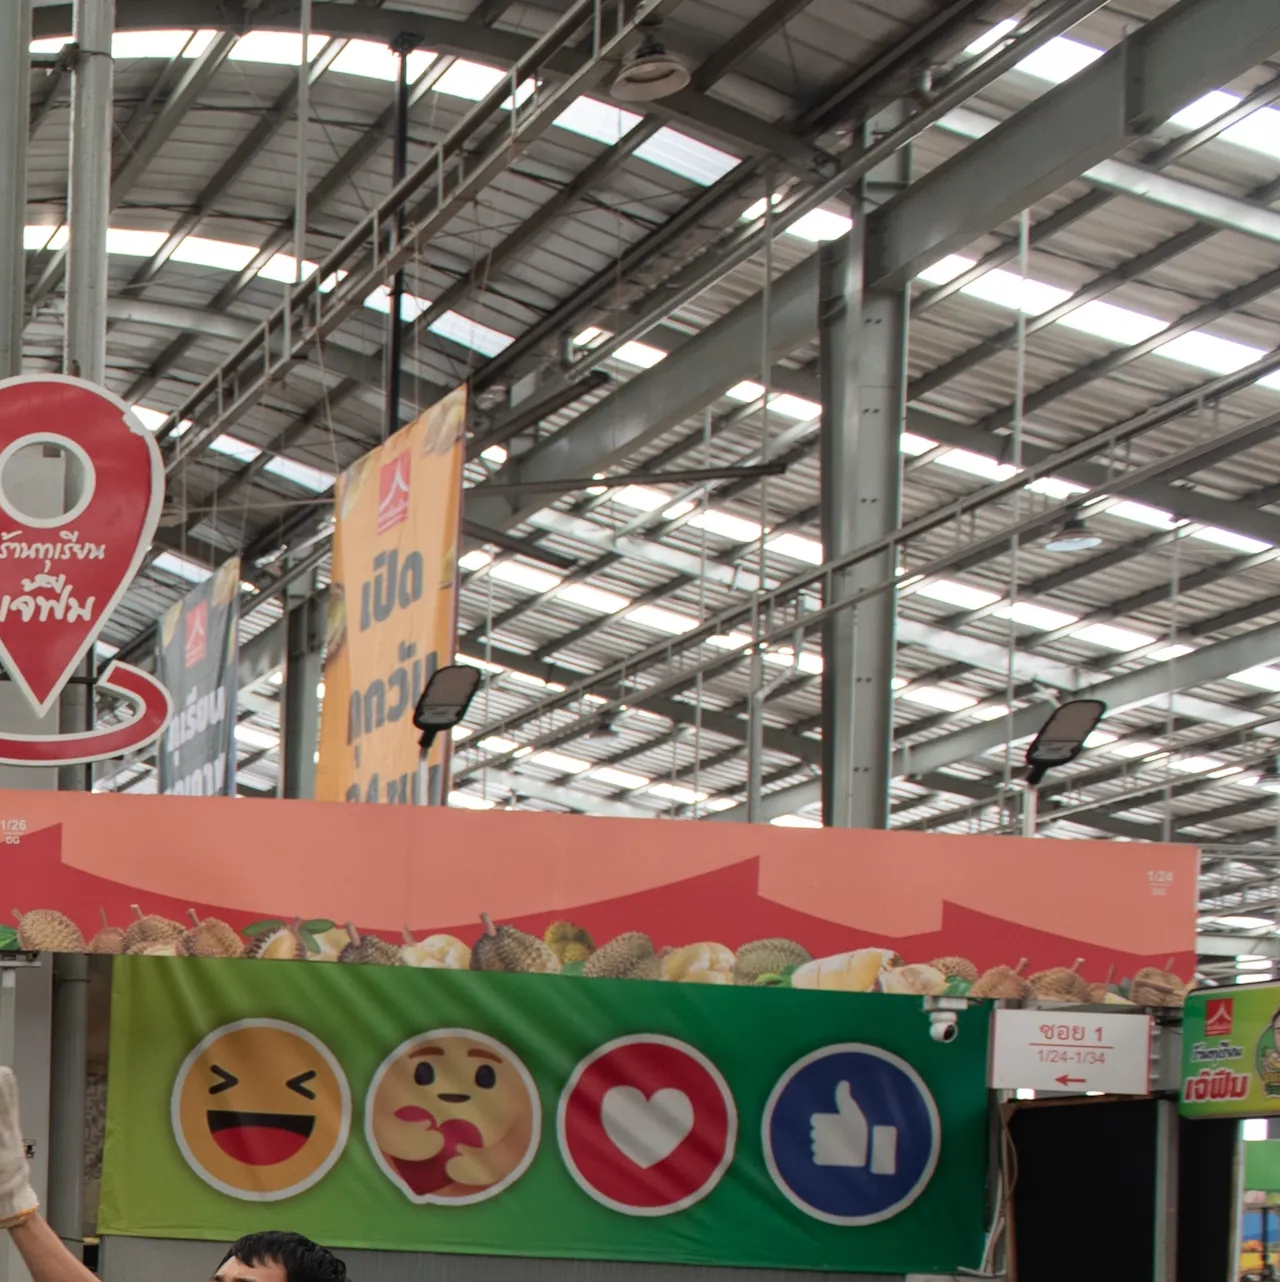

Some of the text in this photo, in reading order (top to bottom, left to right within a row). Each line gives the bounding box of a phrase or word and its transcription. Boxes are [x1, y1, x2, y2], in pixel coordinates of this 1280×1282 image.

[360, 549, 424, 632] เปิด
[0, 819, 27, 831] 1/26
[1039, 1024, 1104, 1042] ซอย 1
[1038, 1050, 1106, 1065] 1/24-1/34
